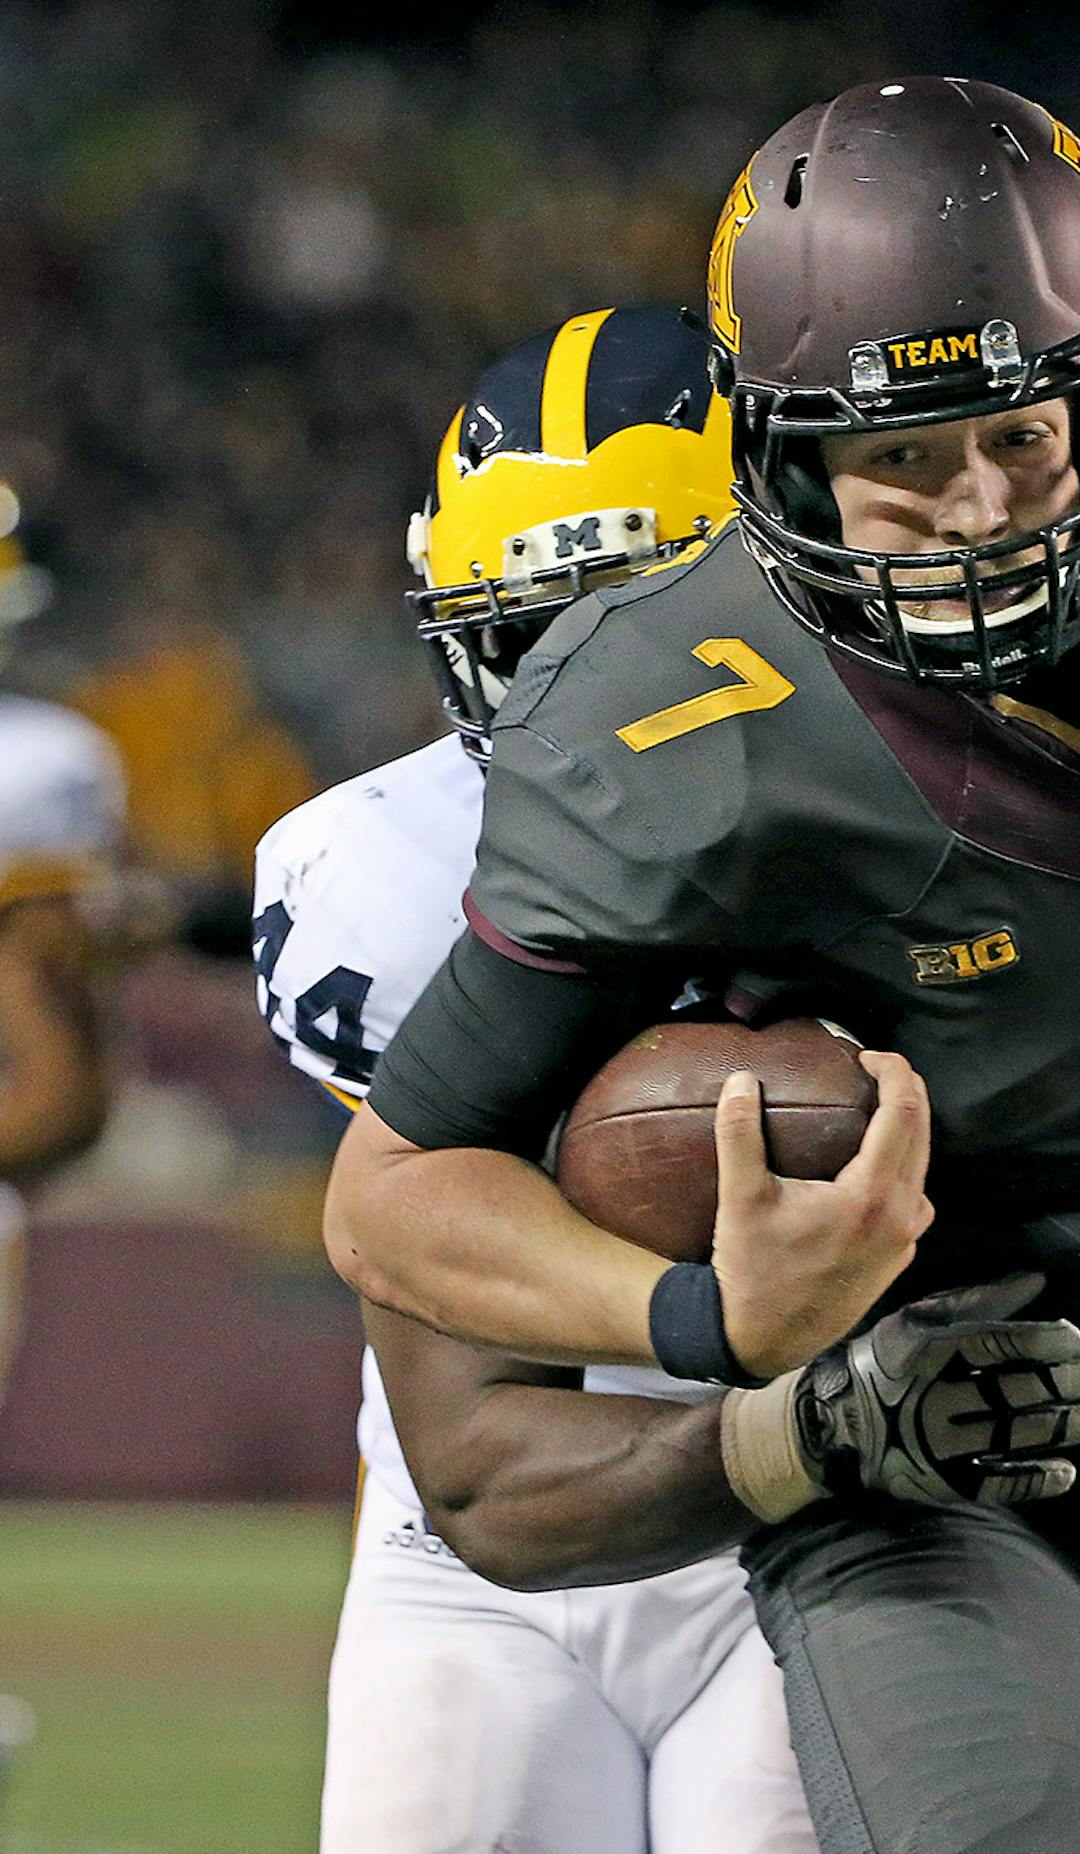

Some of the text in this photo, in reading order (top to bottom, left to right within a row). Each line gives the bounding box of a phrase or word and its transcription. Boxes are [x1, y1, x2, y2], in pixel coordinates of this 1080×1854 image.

[888, 333, 980, 369] TEAM
[552, 516, 602, 558] M
[614, 636, 797, 754] 7
